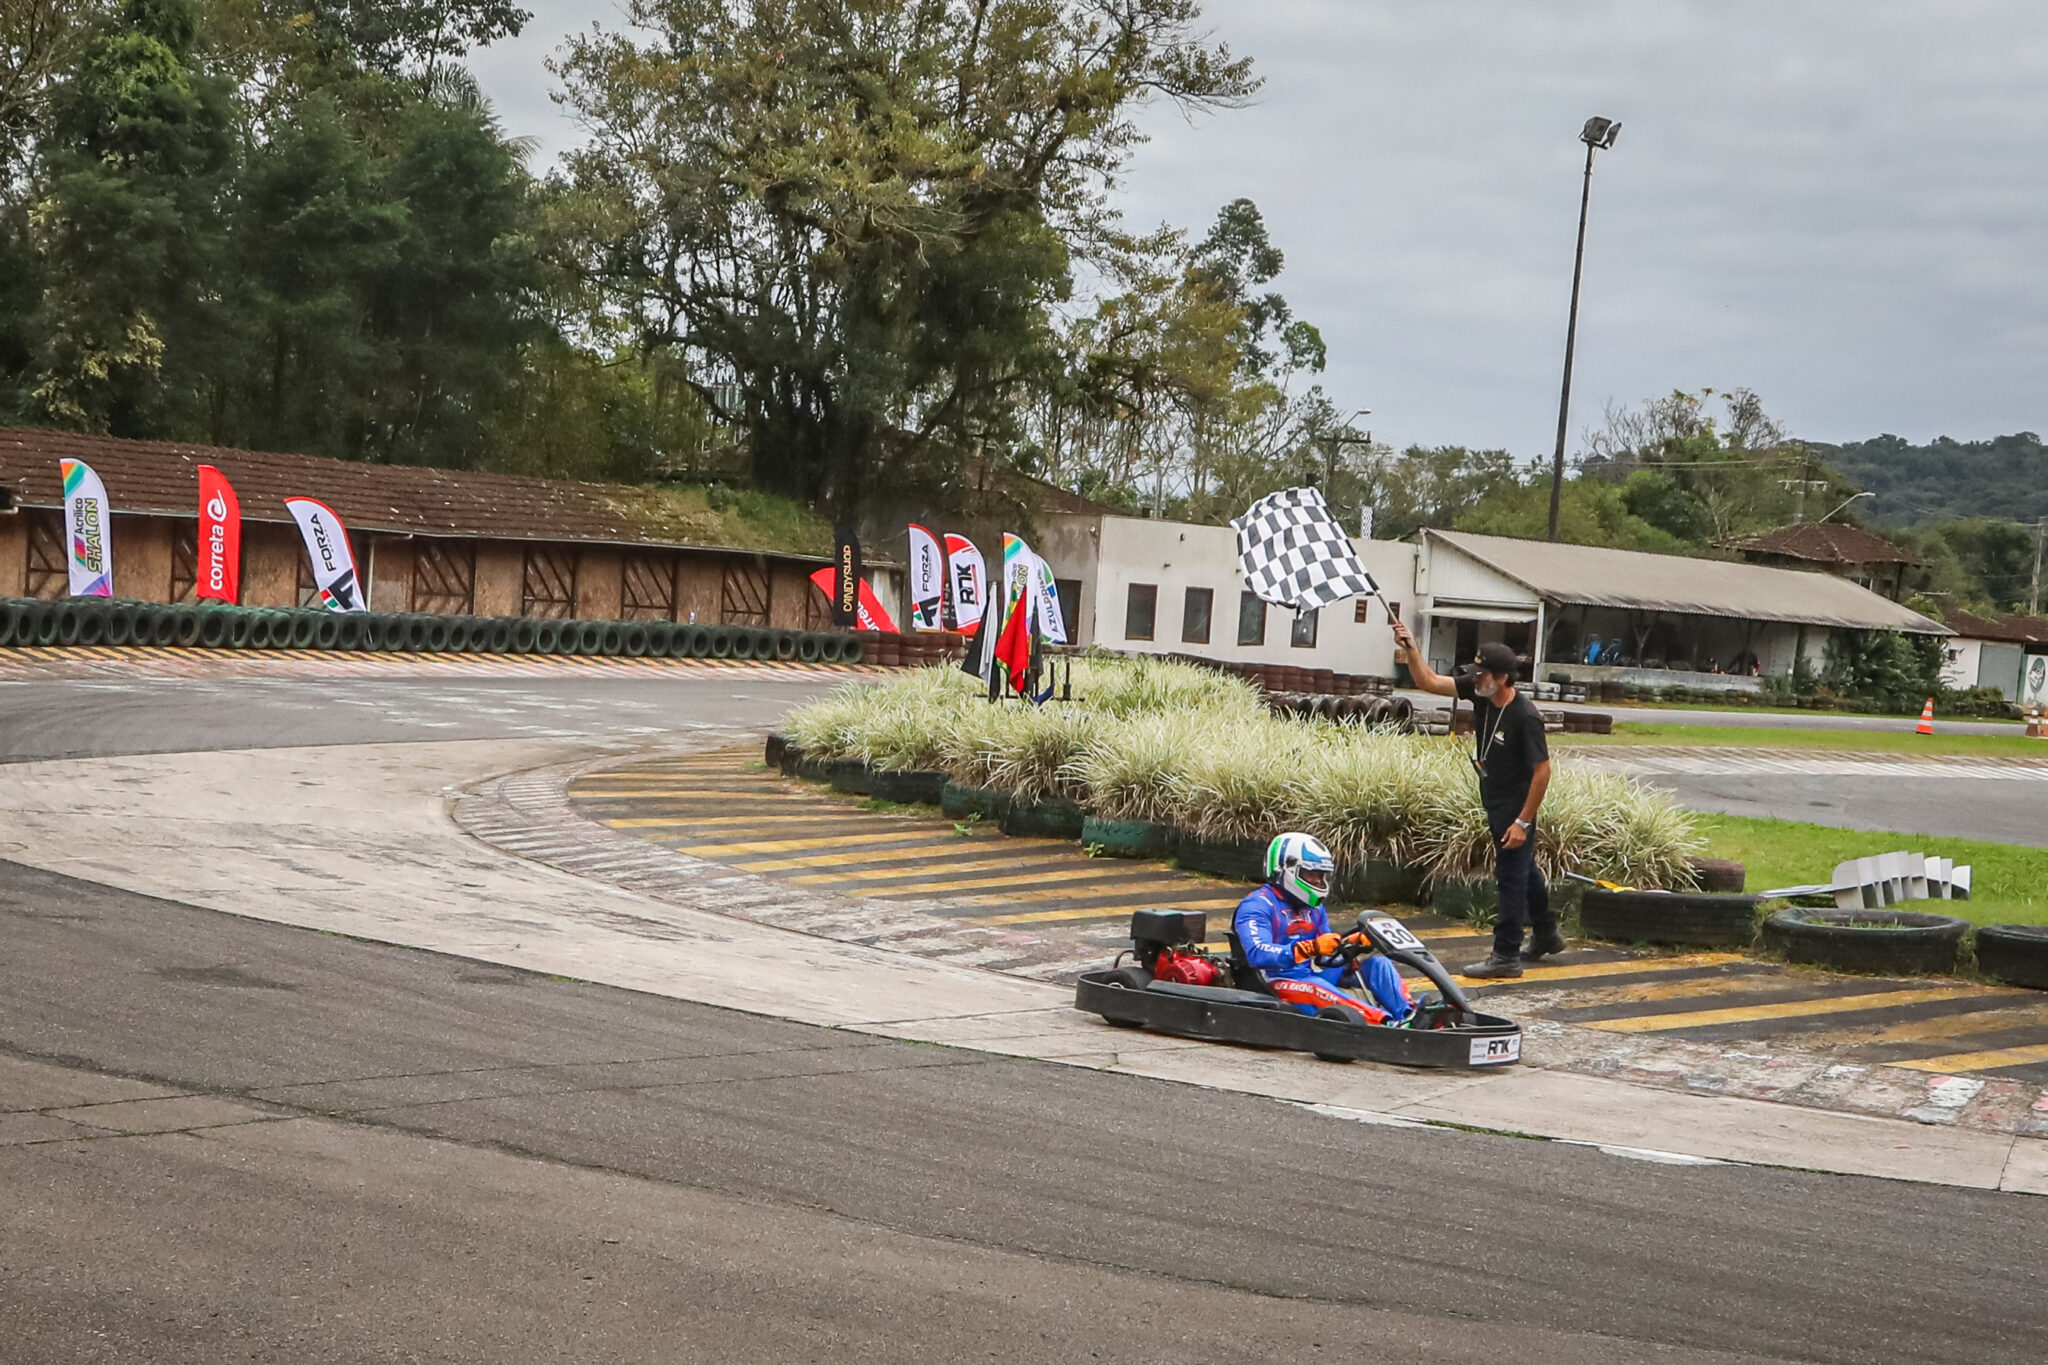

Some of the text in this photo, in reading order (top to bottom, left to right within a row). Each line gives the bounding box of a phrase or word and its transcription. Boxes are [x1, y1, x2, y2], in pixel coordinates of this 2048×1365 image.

[84, 497, 103, 574] SHALON
[208, 524, 224, 591] correta
[310, 512, 337, 572] FORZA
[921, 544, 930, 592] FORZA
[1382, 928, 1416, 945] 30
